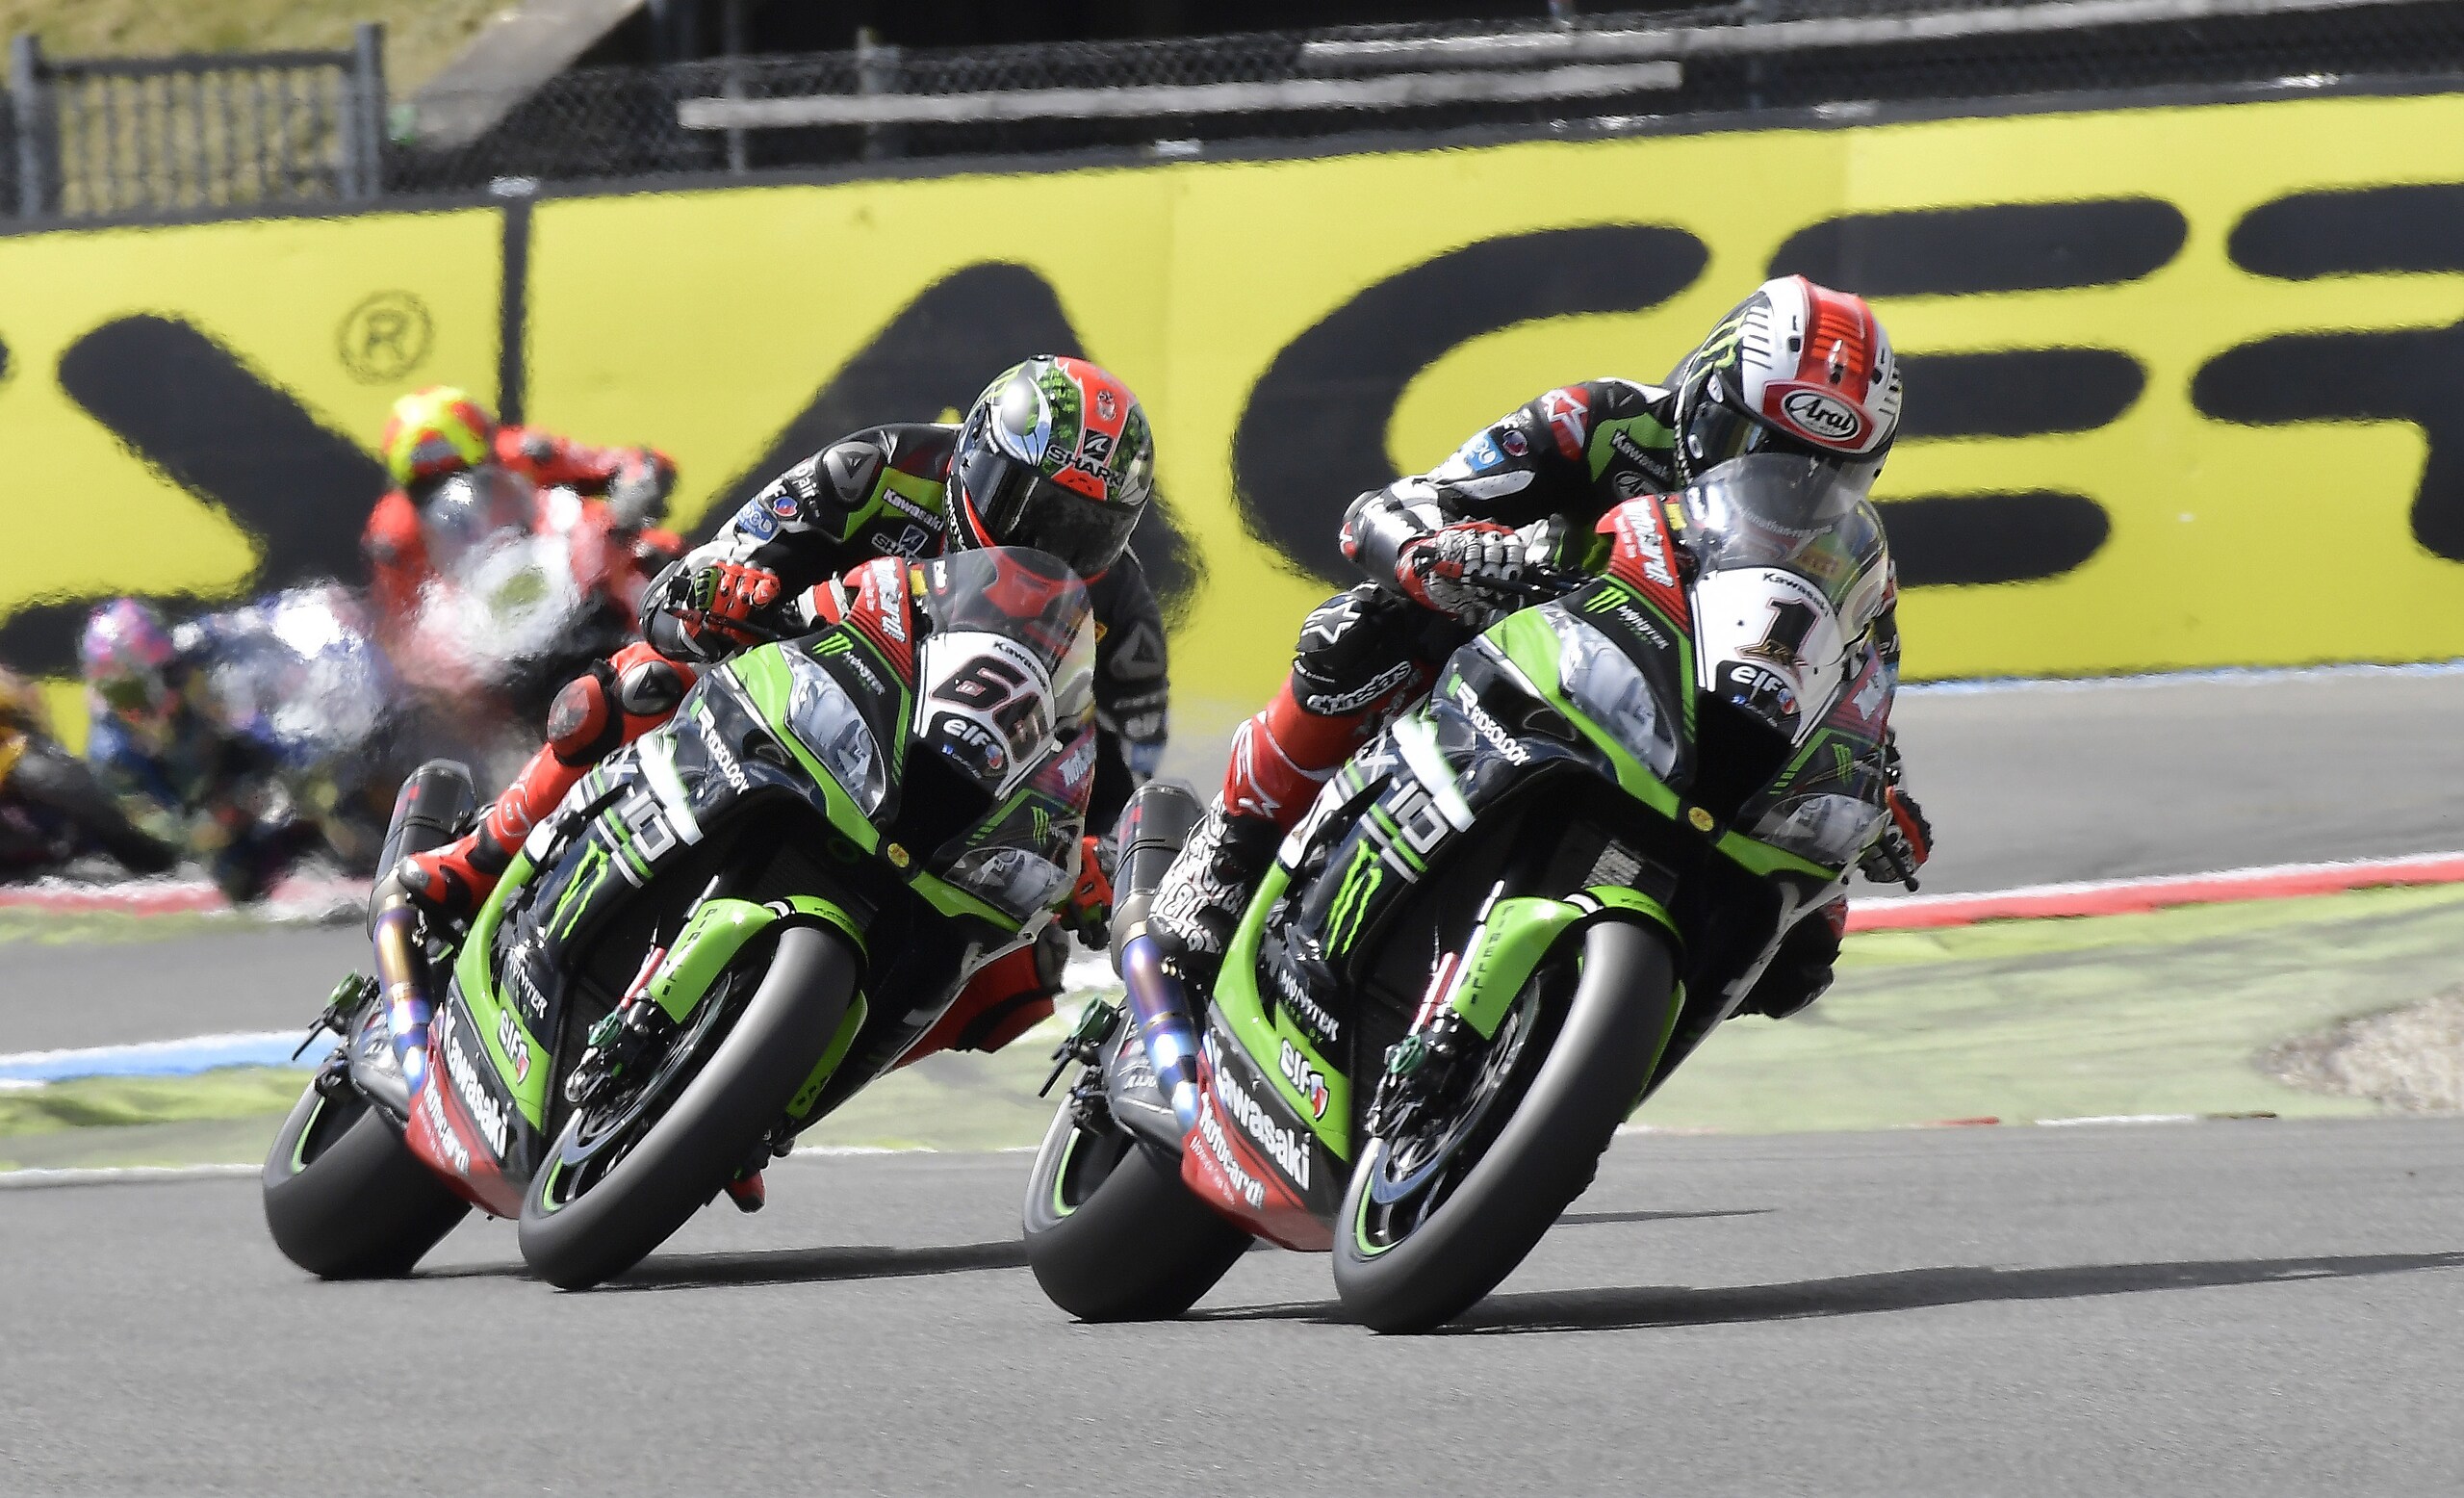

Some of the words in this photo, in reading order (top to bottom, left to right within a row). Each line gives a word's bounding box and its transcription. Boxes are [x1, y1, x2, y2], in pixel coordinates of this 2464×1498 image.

[1791, 399, 1854, 430] Arai
[1048, 443, 1127, 488] SHARK
[883, 487, 945, 531] Kawasaki
[1734, 596, 1812, 666] 1
[1730, 665, 1784, 692] elf
[706, 725, 751, 796] RIDEOLOGY
[942, 718, 995, 749] elf
[1469, 706, 1531, 767] RIDEOLOGY
[444, 1004, 508, 1160] Kawasaki
[1279, 1039, 1312, 1096] elf
[1209, 1026, 1312, 1192] Kawasaki
